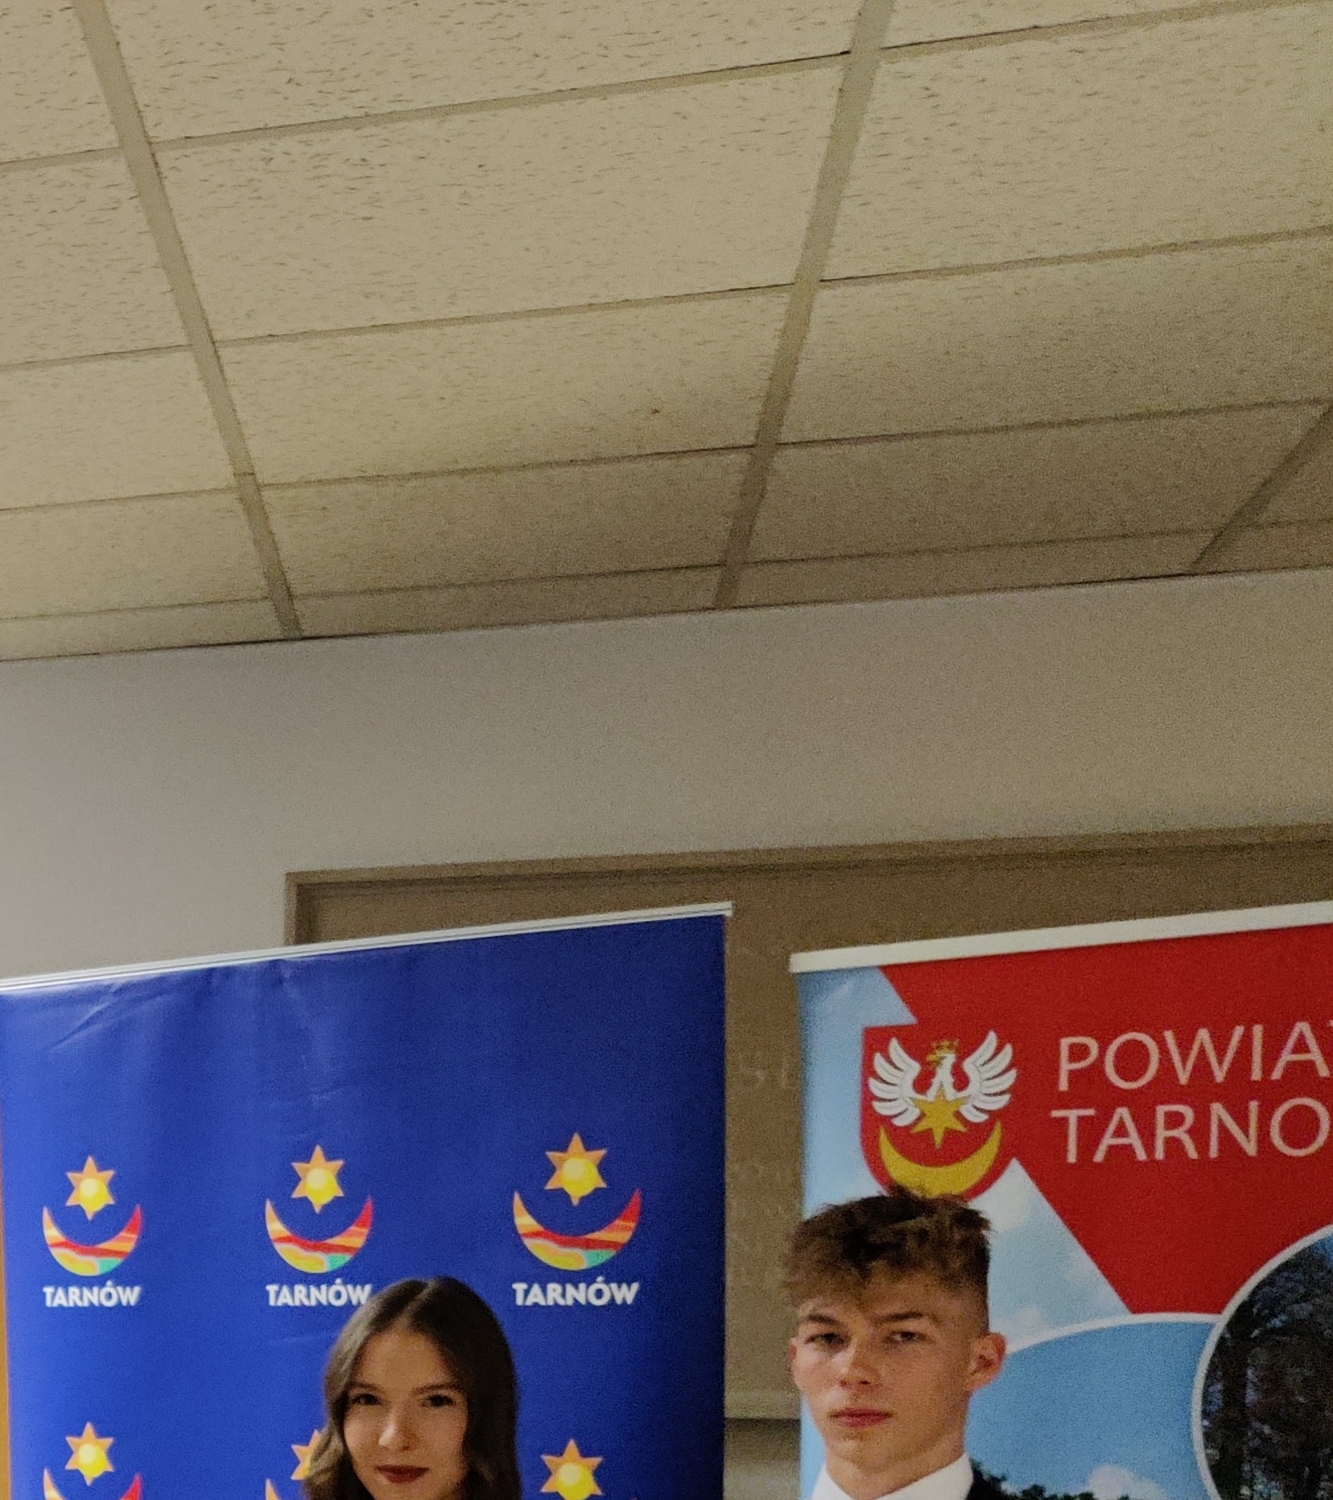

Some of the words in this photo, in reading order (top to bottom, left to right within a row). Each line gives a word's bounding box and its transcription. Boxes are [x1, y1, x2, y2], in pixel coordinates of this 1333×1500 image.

[1057, 1019, 1333, 1093] POWIA
[1050, 1096, 1332, 1164] TARNO
[42, 1280, 141, 1308] TARNÓW
[265, 1278, 373, 1307] TARNÓW
[511, 1275, 640, 1307] TARNÓW
